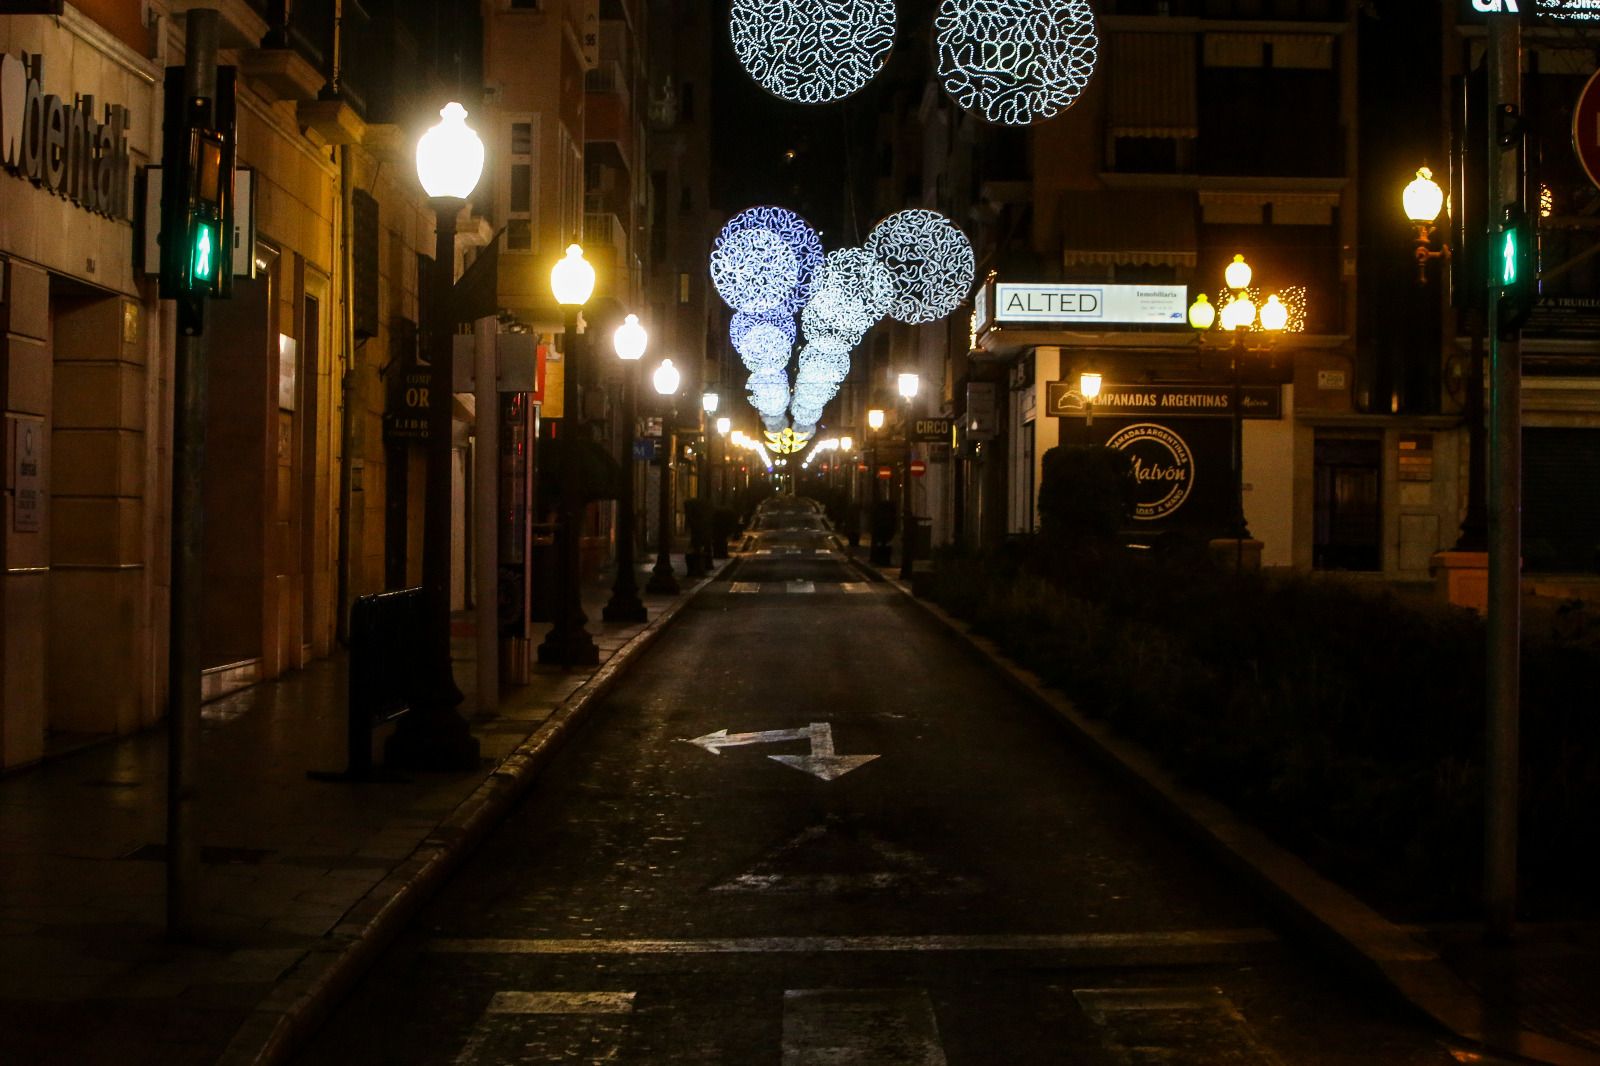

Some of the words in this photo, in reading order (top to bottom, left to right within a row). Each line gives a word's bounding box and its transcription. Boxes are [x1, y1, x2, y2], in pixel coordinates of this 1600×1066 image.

[1006, 293, 1097, 312] ALTED
[406, 388, 430, 408] OR
[1161, 394, 1229, 408] ARGENTINAS
[395, 418, 430, 429] LIBR
[916, 420, 948, 434] CIRCO
